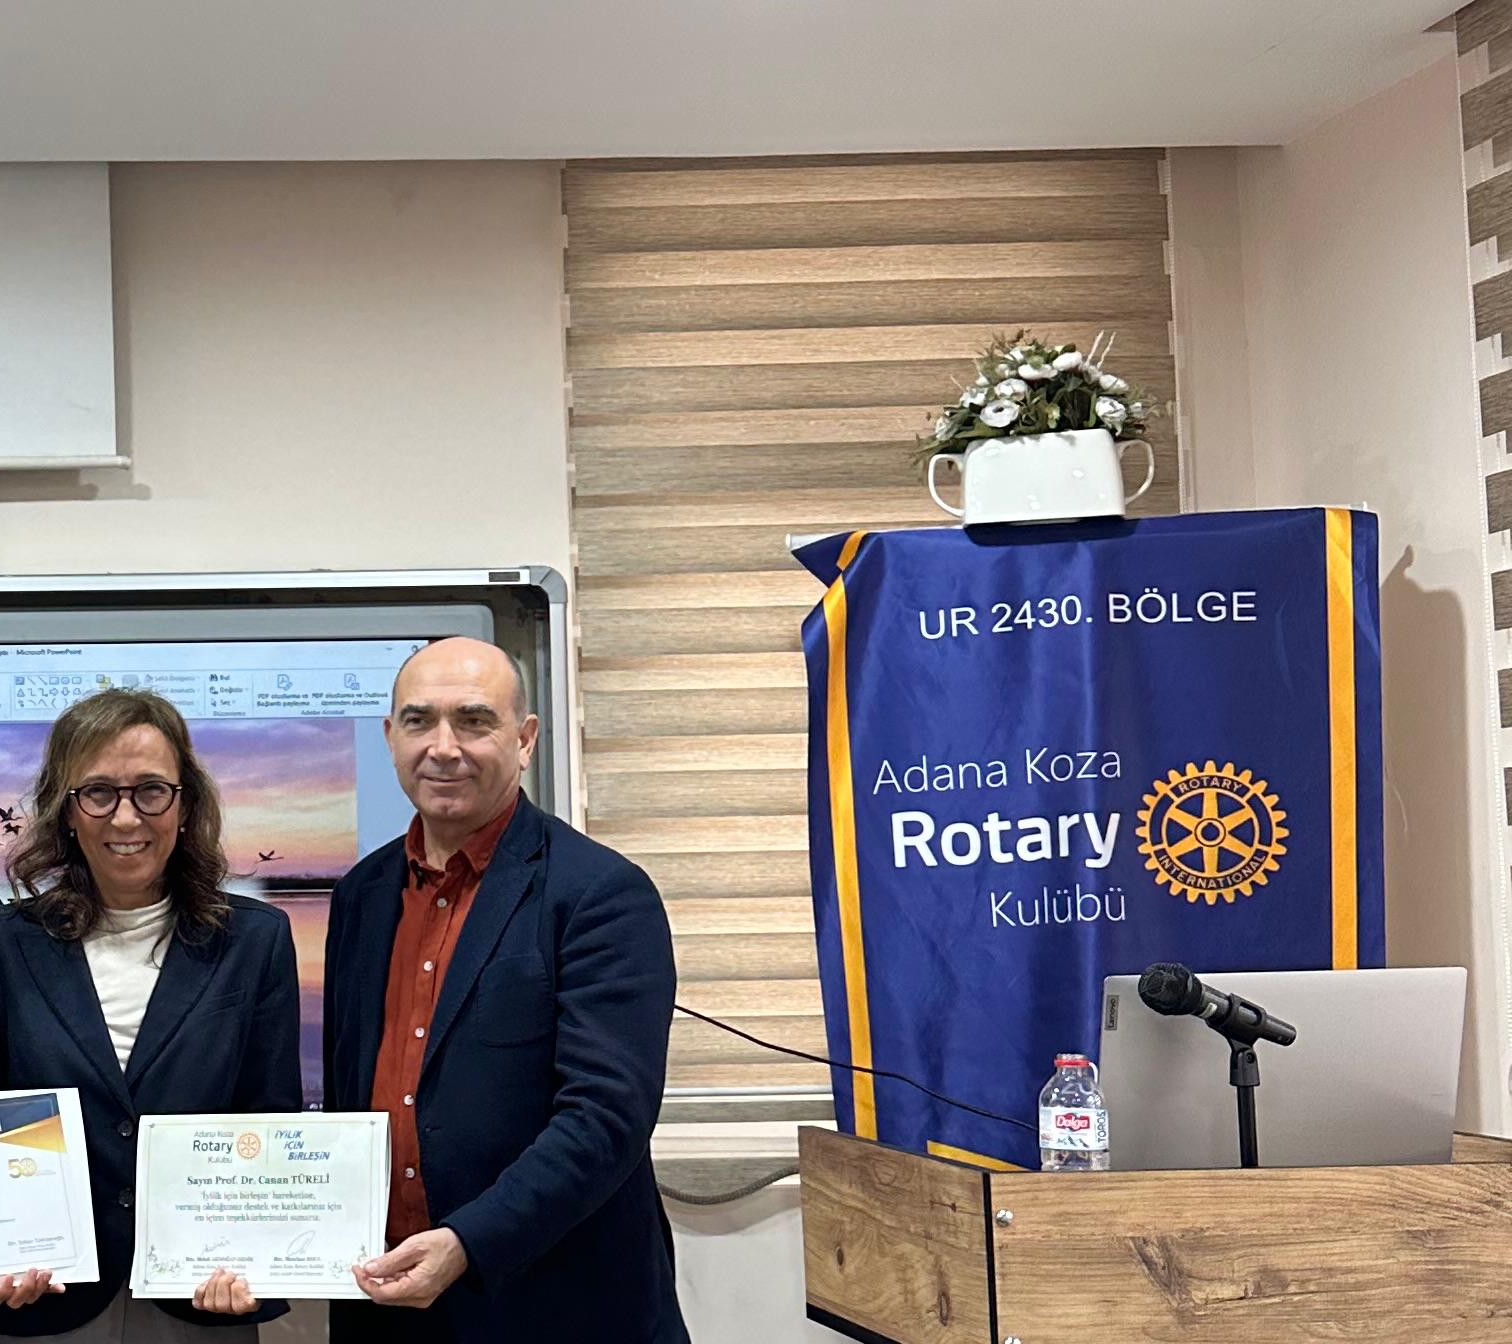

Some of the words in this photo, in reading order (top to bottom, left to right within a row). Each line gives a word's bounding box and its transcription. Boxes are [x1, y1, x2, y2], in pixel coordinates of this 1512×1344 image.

[918, 605, 979, 640] UR
[990, 593, 1094, 635] 2430.
[1107, 586, 1258, 624] BÖLGE
[872, 753, 1008, 795] Adana
[1024, 746, 1122, 784] Koza
[1177, 776, 1243, 794] ROTARY
[889, 808, 1121, 870] Rotary
[1158, 853, 1266, 890] INTERNATIONAL
[990, 883, 1128, 928] Kulübü
[1055, 1114, 1090, 1131] Dalga
[193, 1140, 233, 1154] Rotary
[187, 1175, 212, 1187] Sayın
[258, 1175, 289, 1185] Canan
[291, 1172, 330, 1185] TÜRELİ
